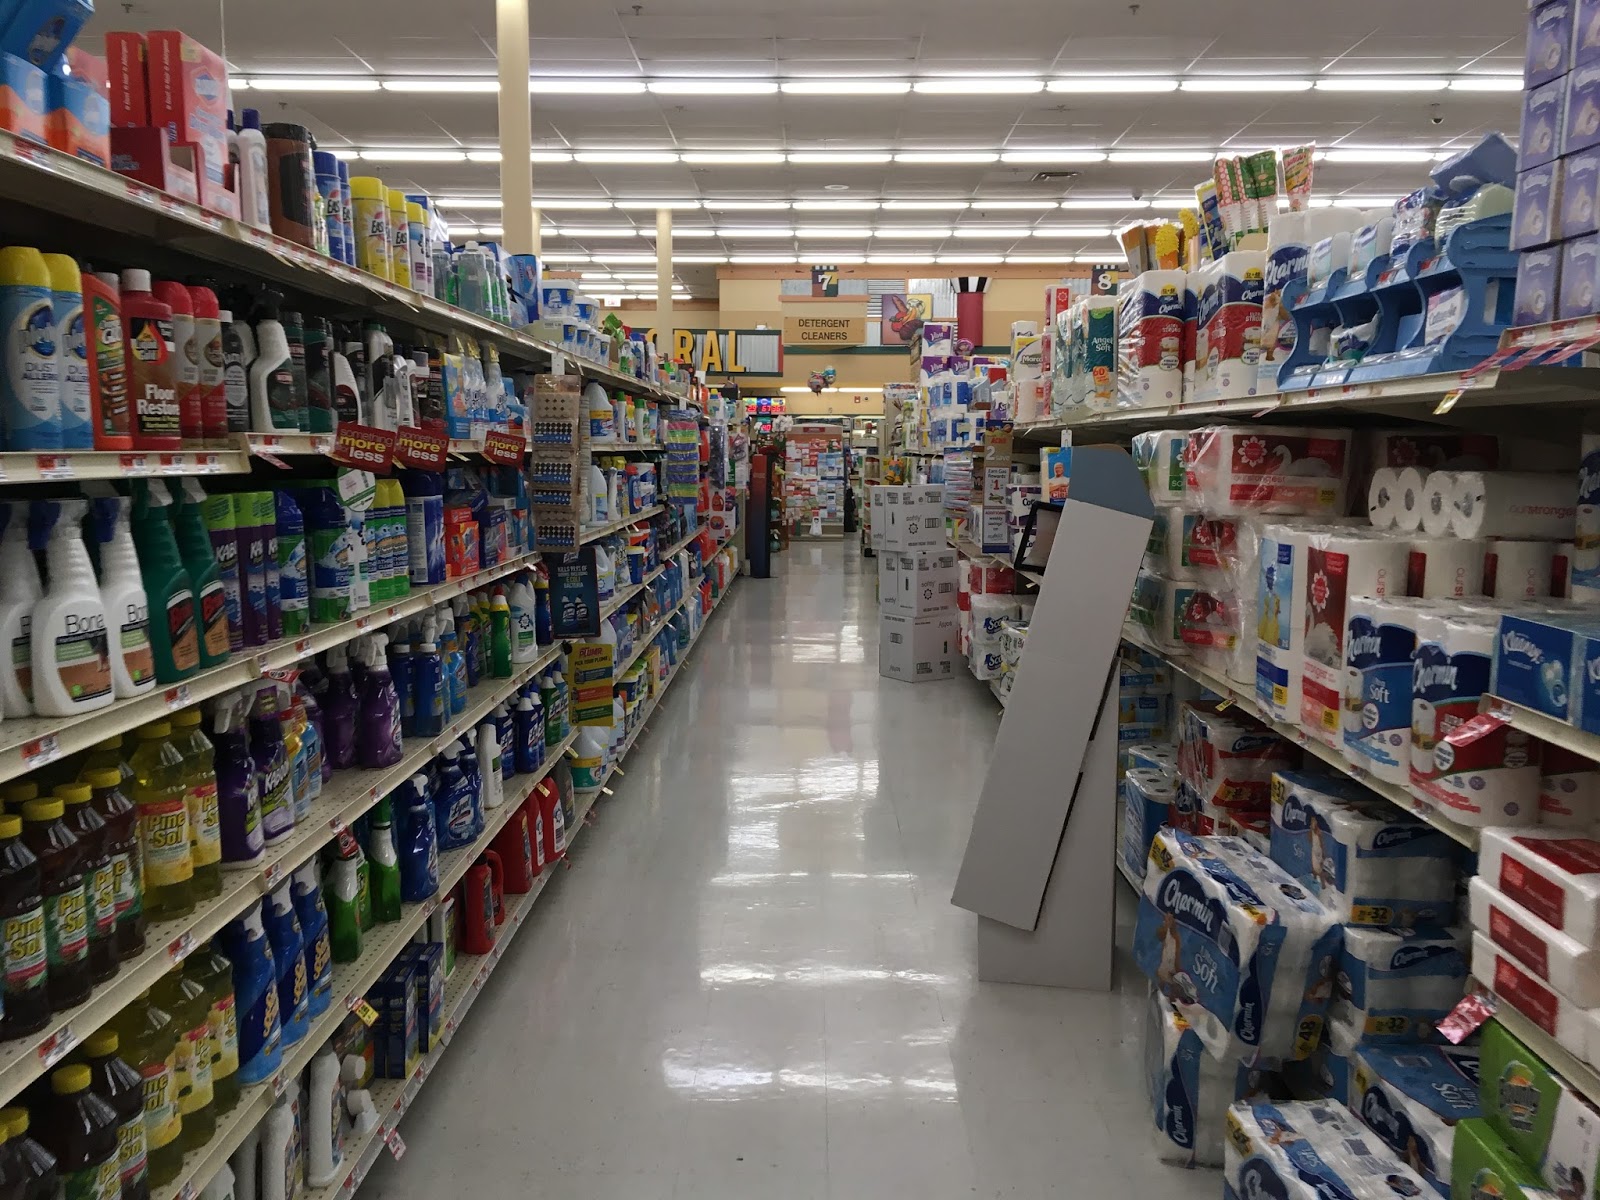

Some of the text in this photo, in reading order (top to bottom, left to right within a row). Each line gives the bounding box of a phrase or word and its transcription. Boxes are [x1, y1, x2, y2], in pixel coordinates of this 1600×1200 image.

[372, 220, 384, 234] EAS
[396, 231, 407, 245] EAS
[1265, 250, 1310, 286] Charmi
[818, 274, 832, 291] 7
[1098, 273, 1112, 290] 8
[1241, 288, 1264, 301] Charm
[1158, 303, 1183, 315] Charmi
[798, 318, 850, 329] DETERGENT
[801, 331, 848, 341] CLEANERS
[1091, 337, 1114, 347] Angel
[1095, 342, 1112, 353] Soft
[145, 384, 176, 400] Floor
[340, 428, 394, 447] something
[340, 436, 387, 453] more
[400, 430, 448, 449] something
[400, 437, 441, 453] more
[487, 439, 520, 453] more
[986, 445, 997, 461] 2
[349, 448, 385, 464] less
[407, 449, 439, 463] less
[493, 449, 518, 460] less
[126, 603, 149, 623] Bon
[1347, 630, 1381, 661] harmin
[1369, 684, 1391, 704] Soft
[149, 814, 186, 832] Pine
[1164, 878, 1214, 932] Charmin
[1192, 954, 1219, 995] Soft
[1240, 1002, 1255, 1041] Charmin
[144, 1073, 169, 1096] ine
[1173, 1105, 1188, 1144] Charmin
